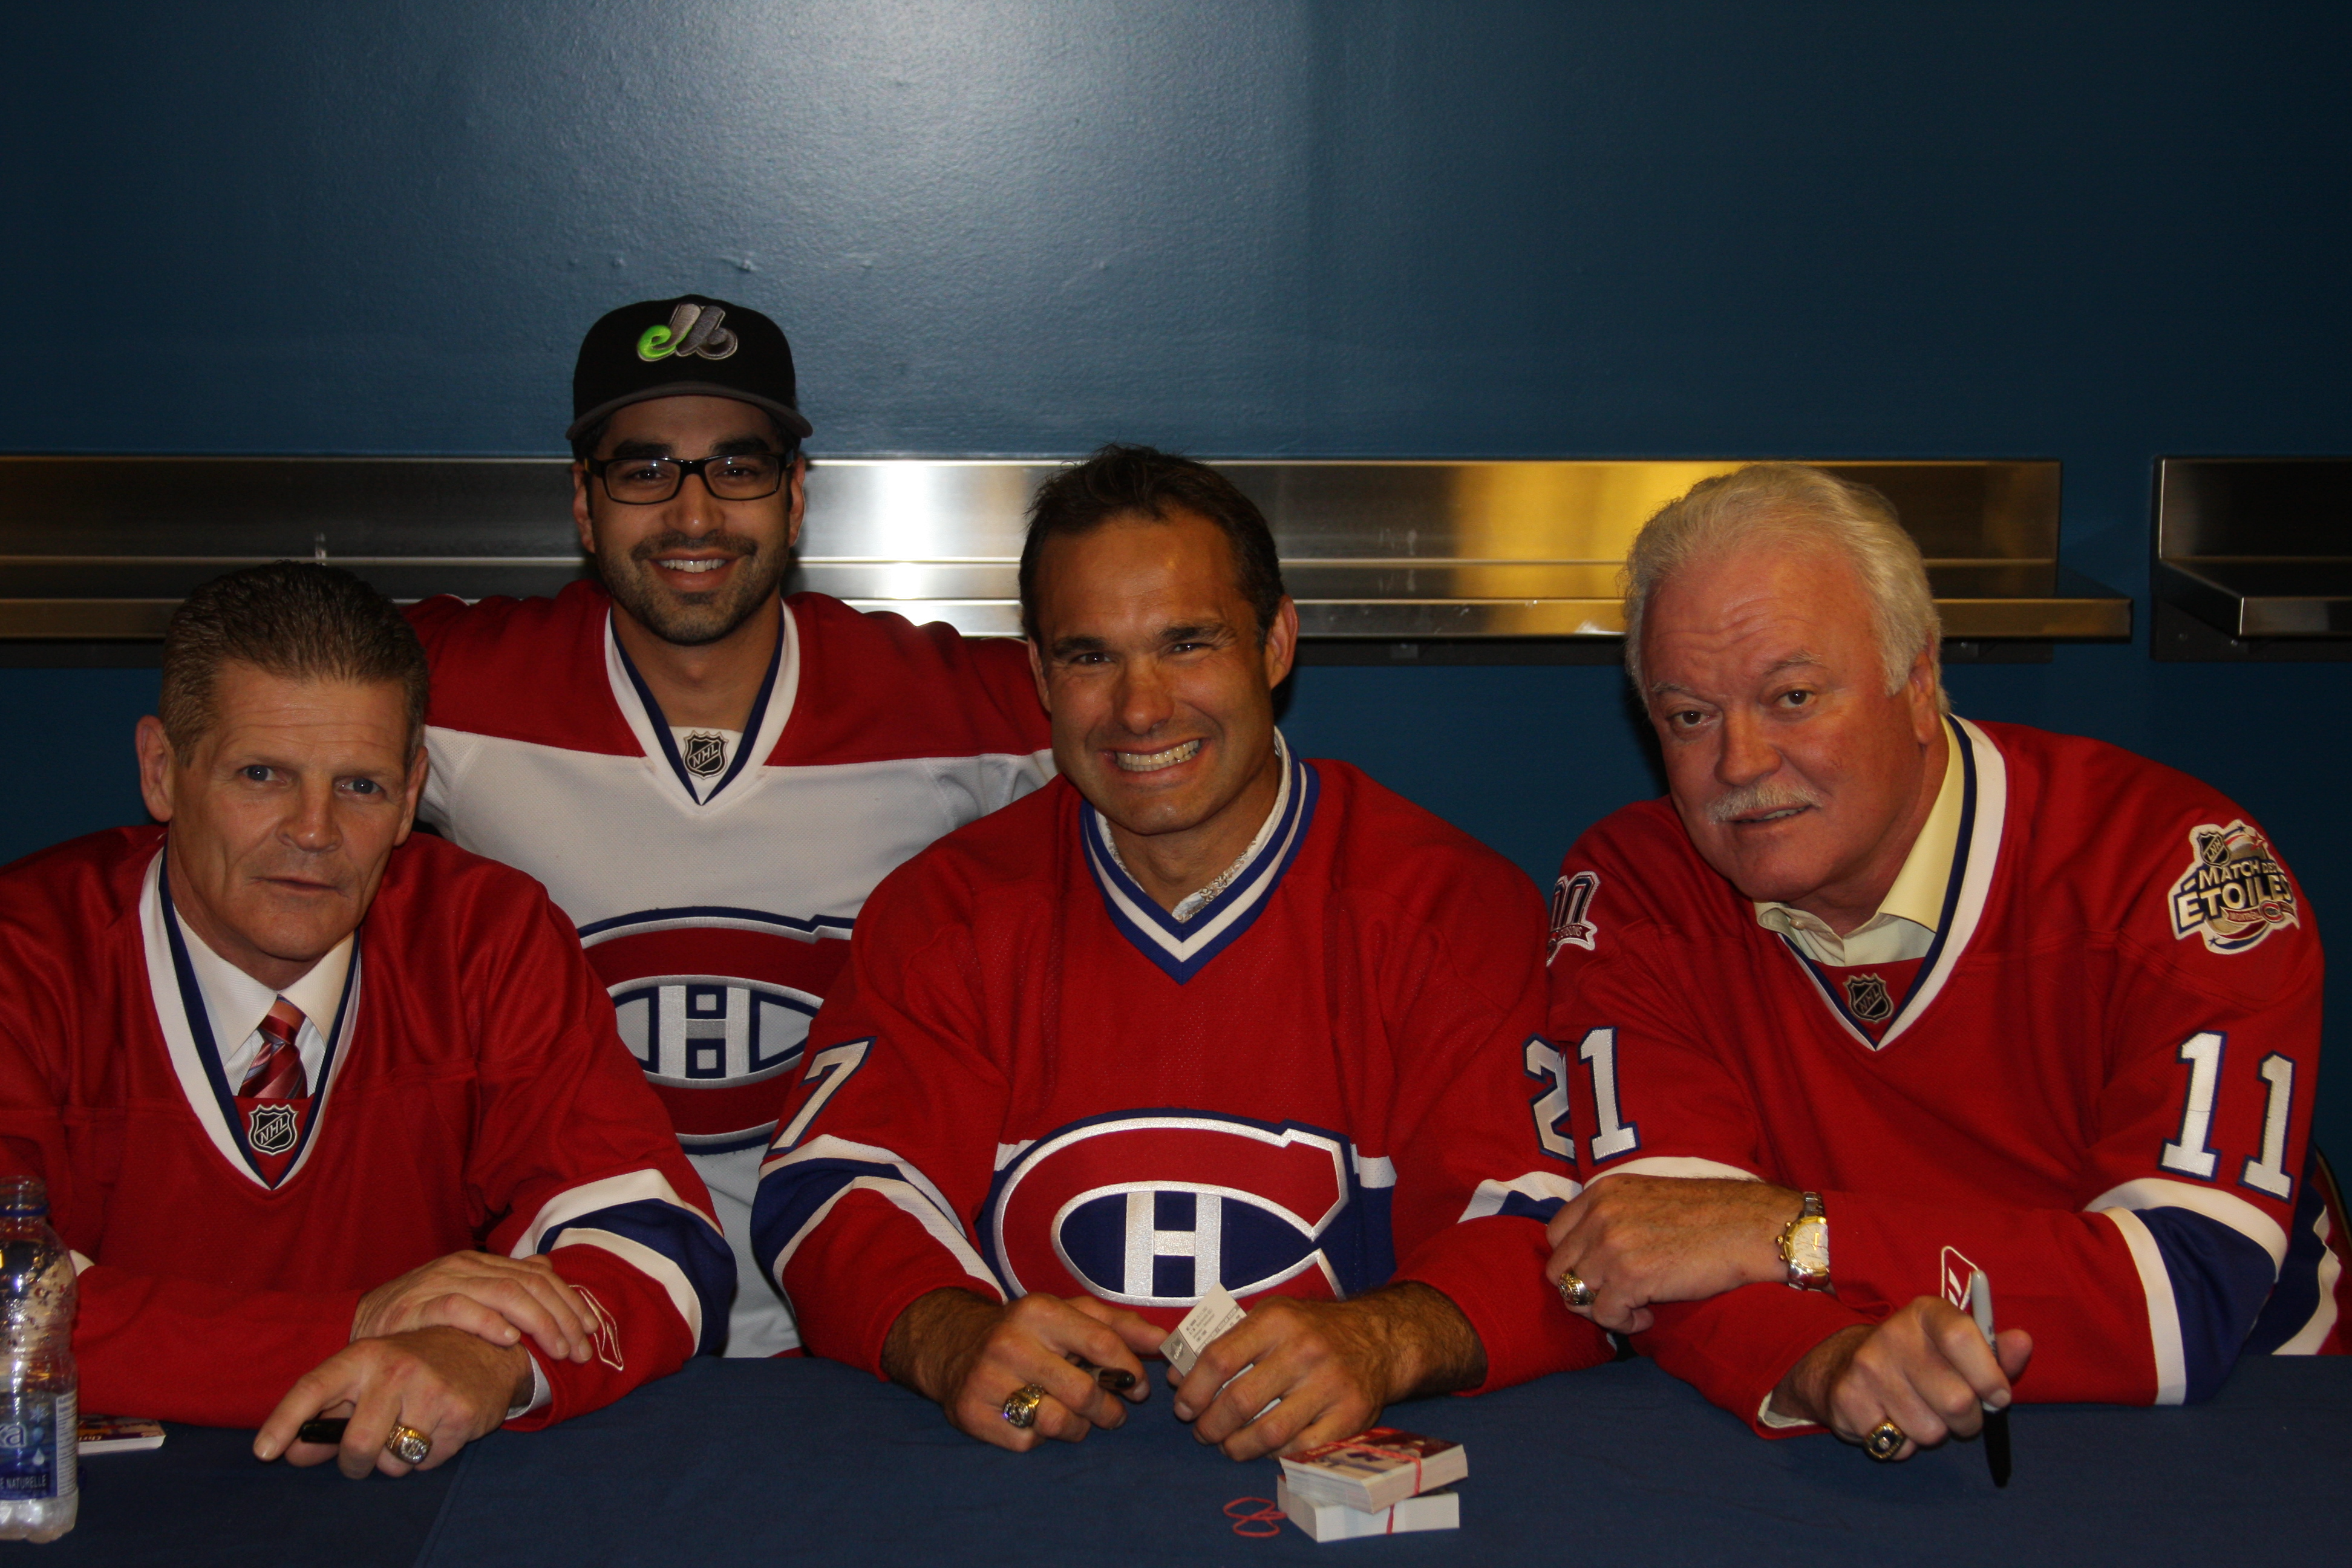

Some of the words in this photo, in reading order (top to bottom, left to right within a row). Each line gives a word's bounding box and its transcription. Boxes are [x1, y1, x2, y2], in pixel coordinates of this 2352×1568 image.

[692, 745, 718, 767] NHL
[2198, 859, 2261, 890] MATCH
[765, 1037, 877, 1158] 7
[260, 1118, 287, 1145] NHL
[2158, 1030, 2296, 1204] 11
[6, 1474, 47, 1489] NATURELLE
